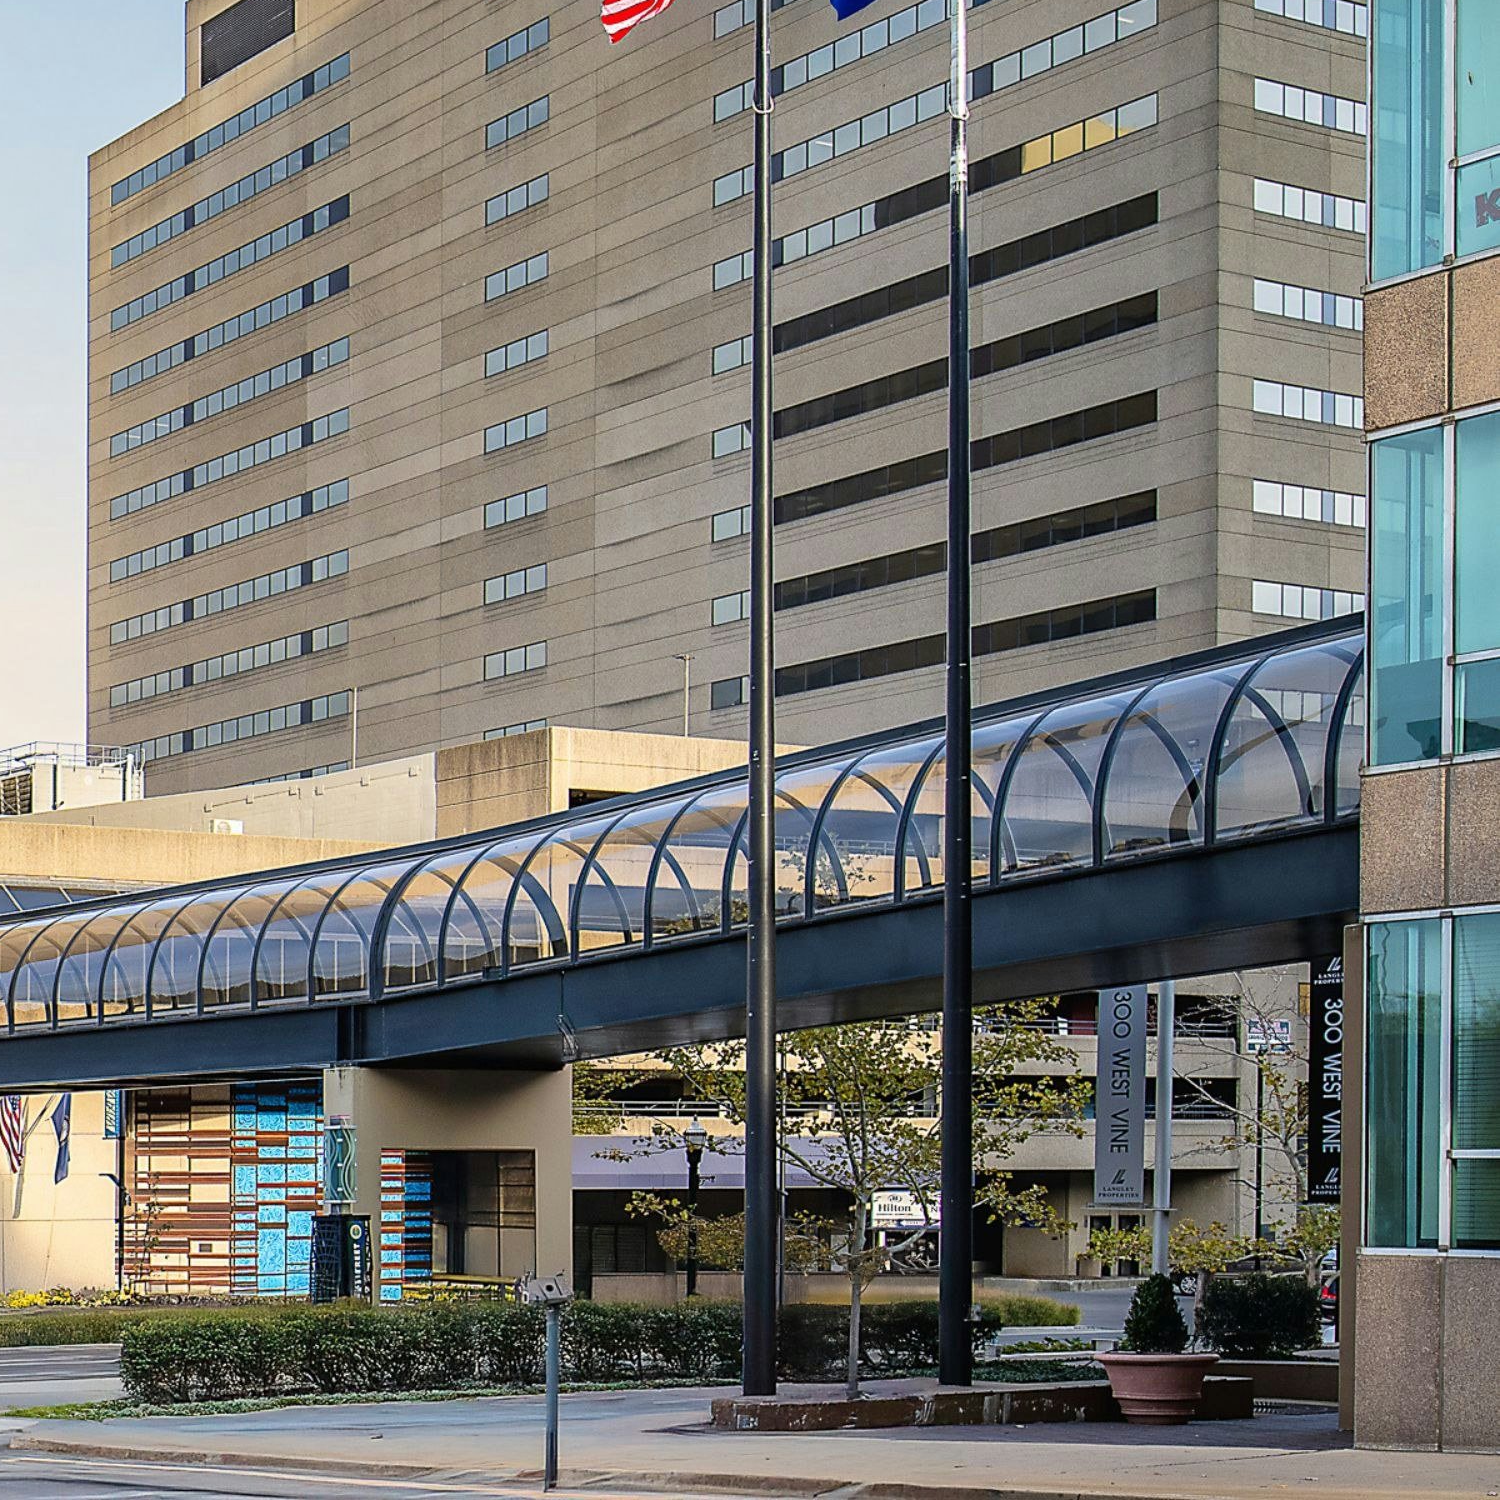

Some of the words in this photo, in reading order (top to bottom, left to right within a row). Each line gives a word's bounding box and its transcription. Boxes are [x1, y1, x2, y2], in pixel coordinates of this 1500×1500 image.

[1113, 991, 1132, 1039] 300
[1323, 998, 1343, 1044] 300
[1111, 1048, 1131, 1098] WEST
[1322, 1053, 1342, 1100] WEST
[1110, 1108, 1129, 1153] VINE
[1322, 1109, 1341, 1153] VINE
[878, 1204, 911, 1212] Hilton
